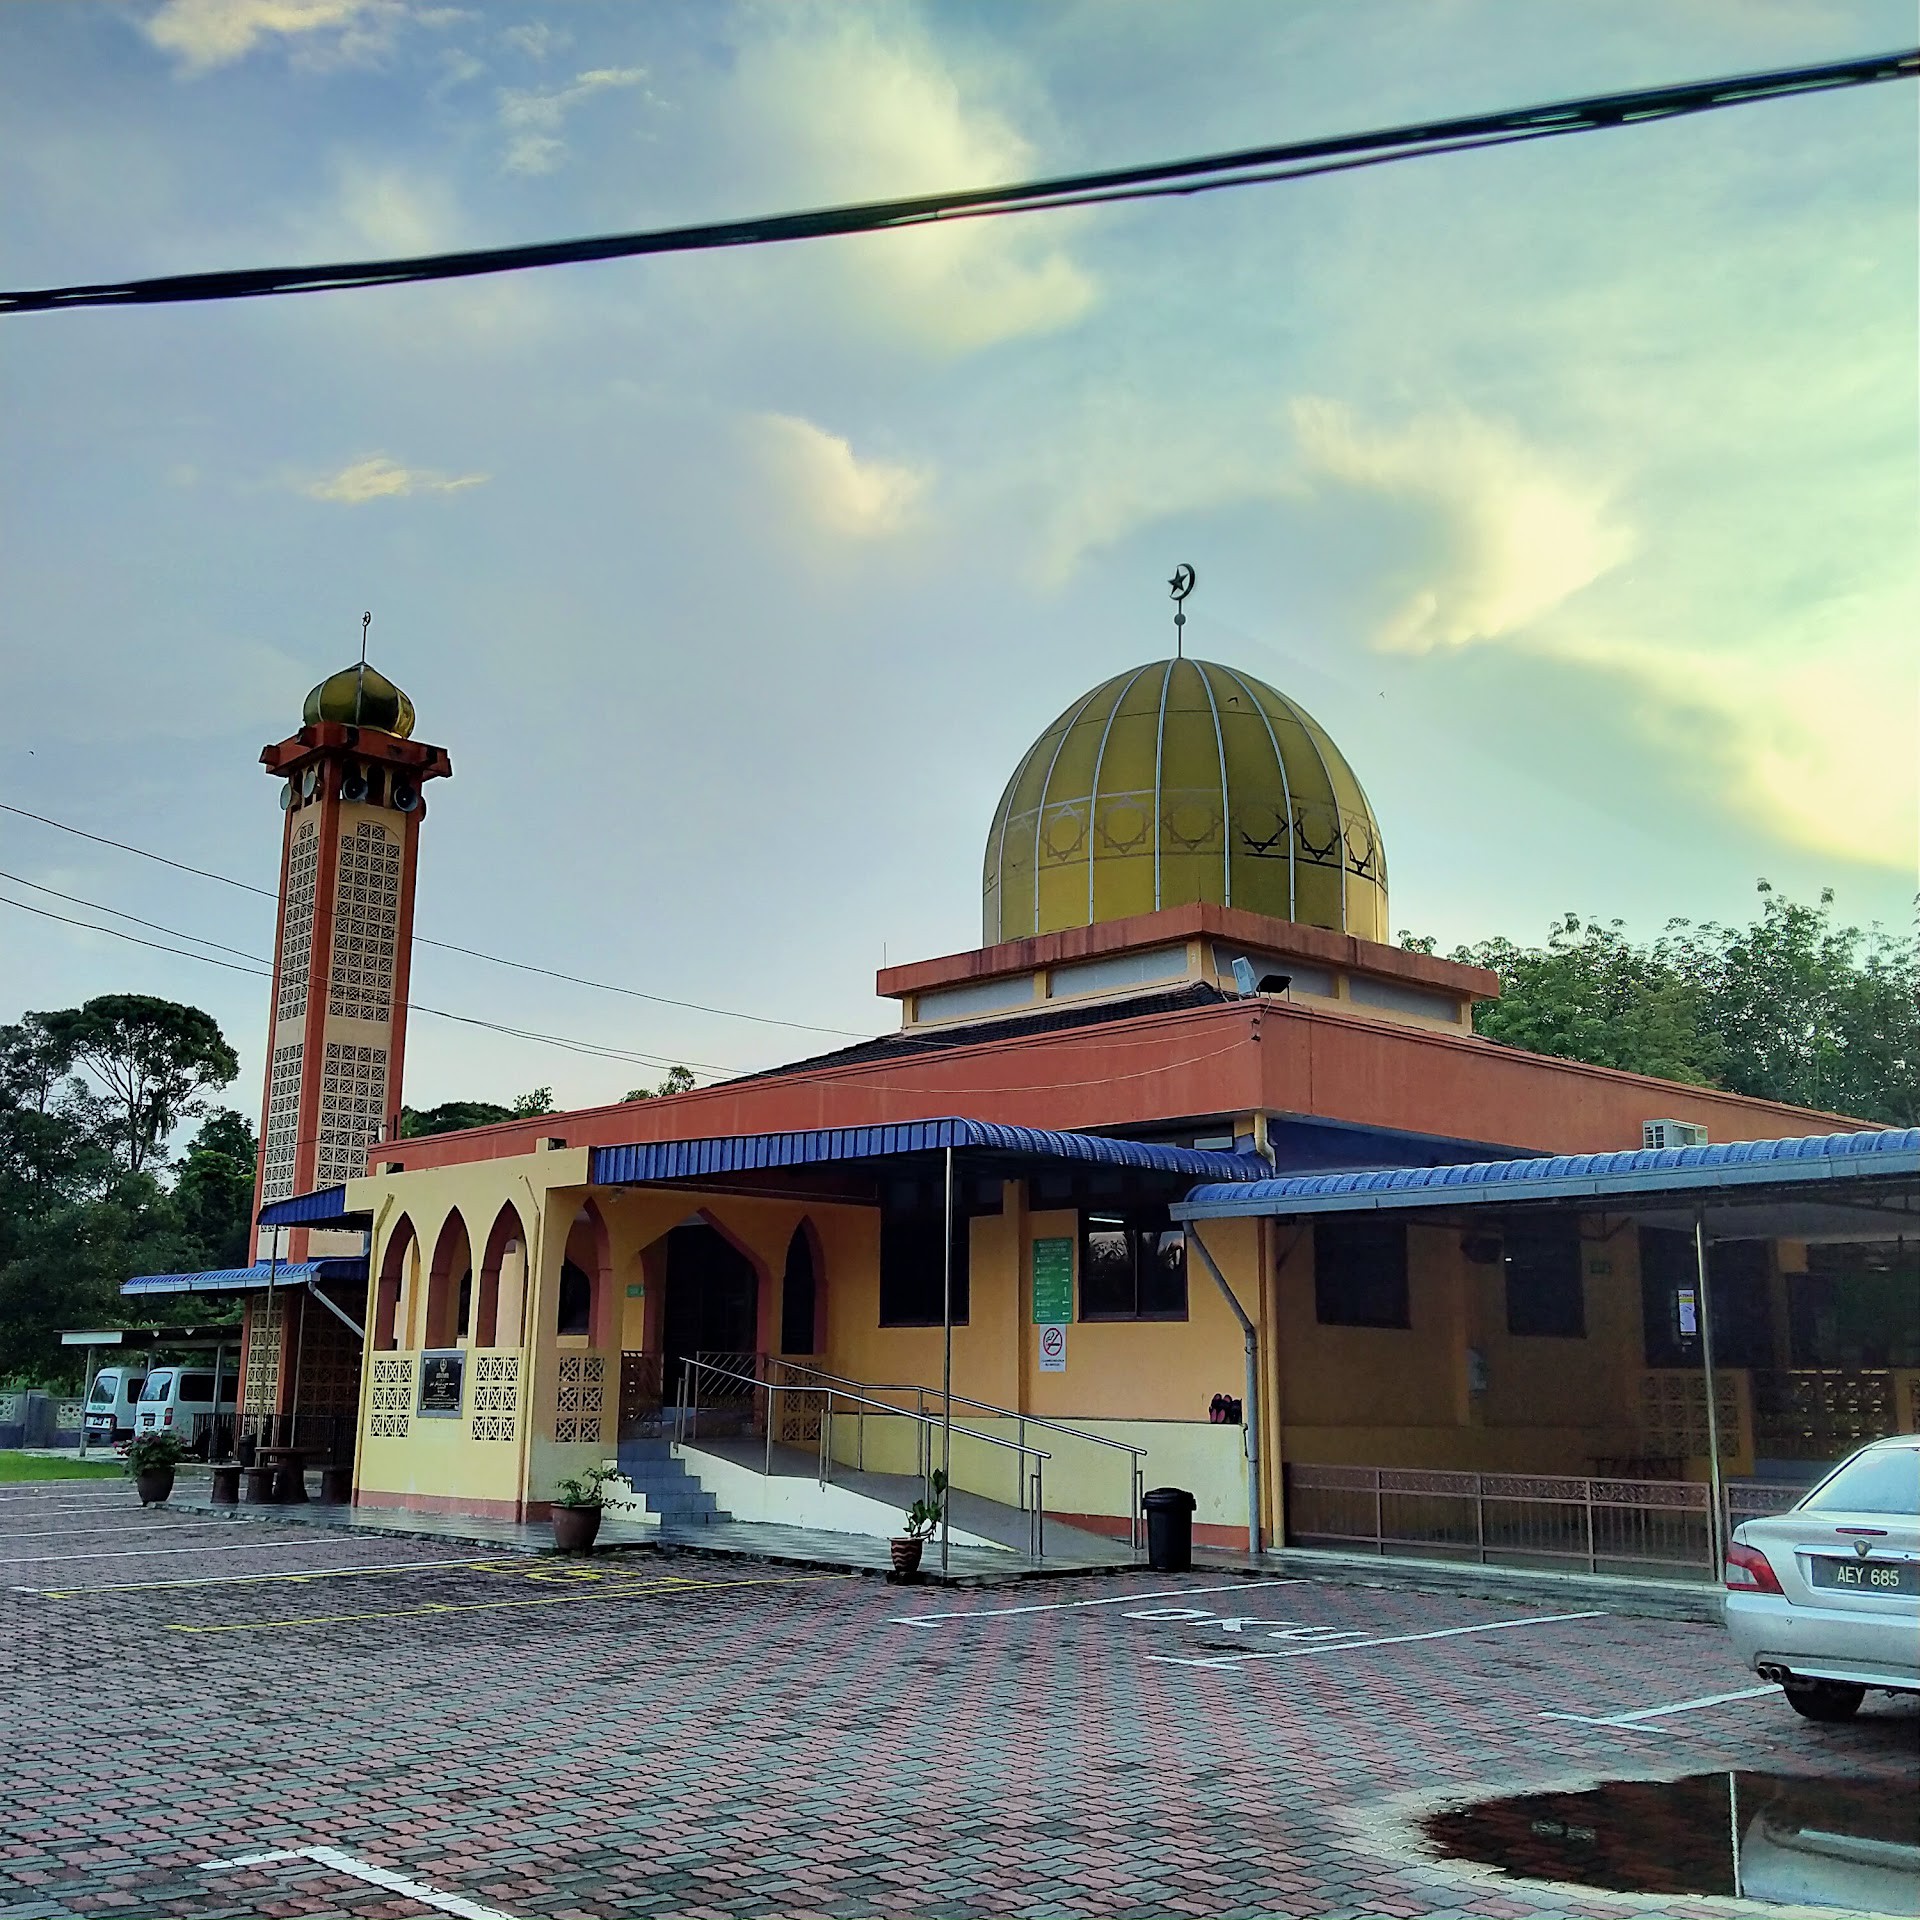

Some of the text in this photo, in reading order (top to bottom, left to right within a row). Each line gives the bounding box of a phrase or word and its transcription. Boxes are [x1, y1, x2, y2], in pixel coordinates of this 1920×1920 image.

[1837, 1565, 1900, 1587] AEY 685
[1121, 1608, 1374, 1641] OKU
